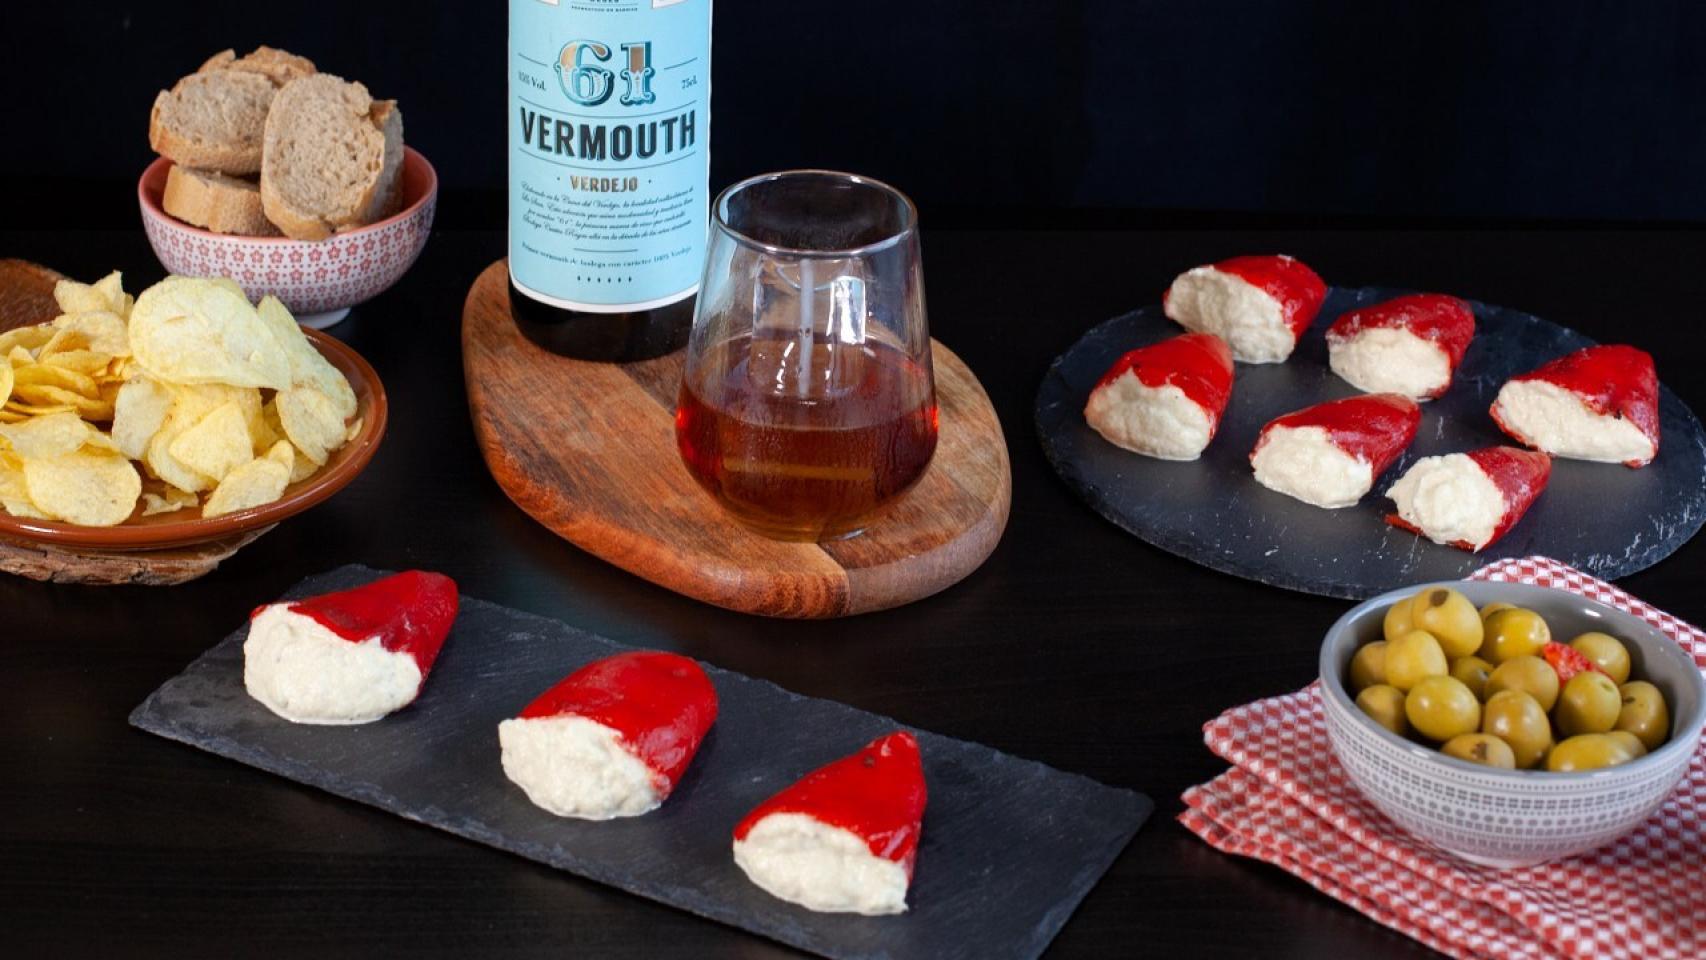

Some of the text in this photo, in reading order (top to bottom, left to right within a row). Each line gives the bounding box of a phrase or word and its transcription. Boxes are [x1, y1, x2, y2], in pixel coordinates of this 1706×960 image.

[553, 38, 656, 107] 61
[520, 106, 696, 162] VERMOUTH
[569, 175, 639, 193] VERDEJO
